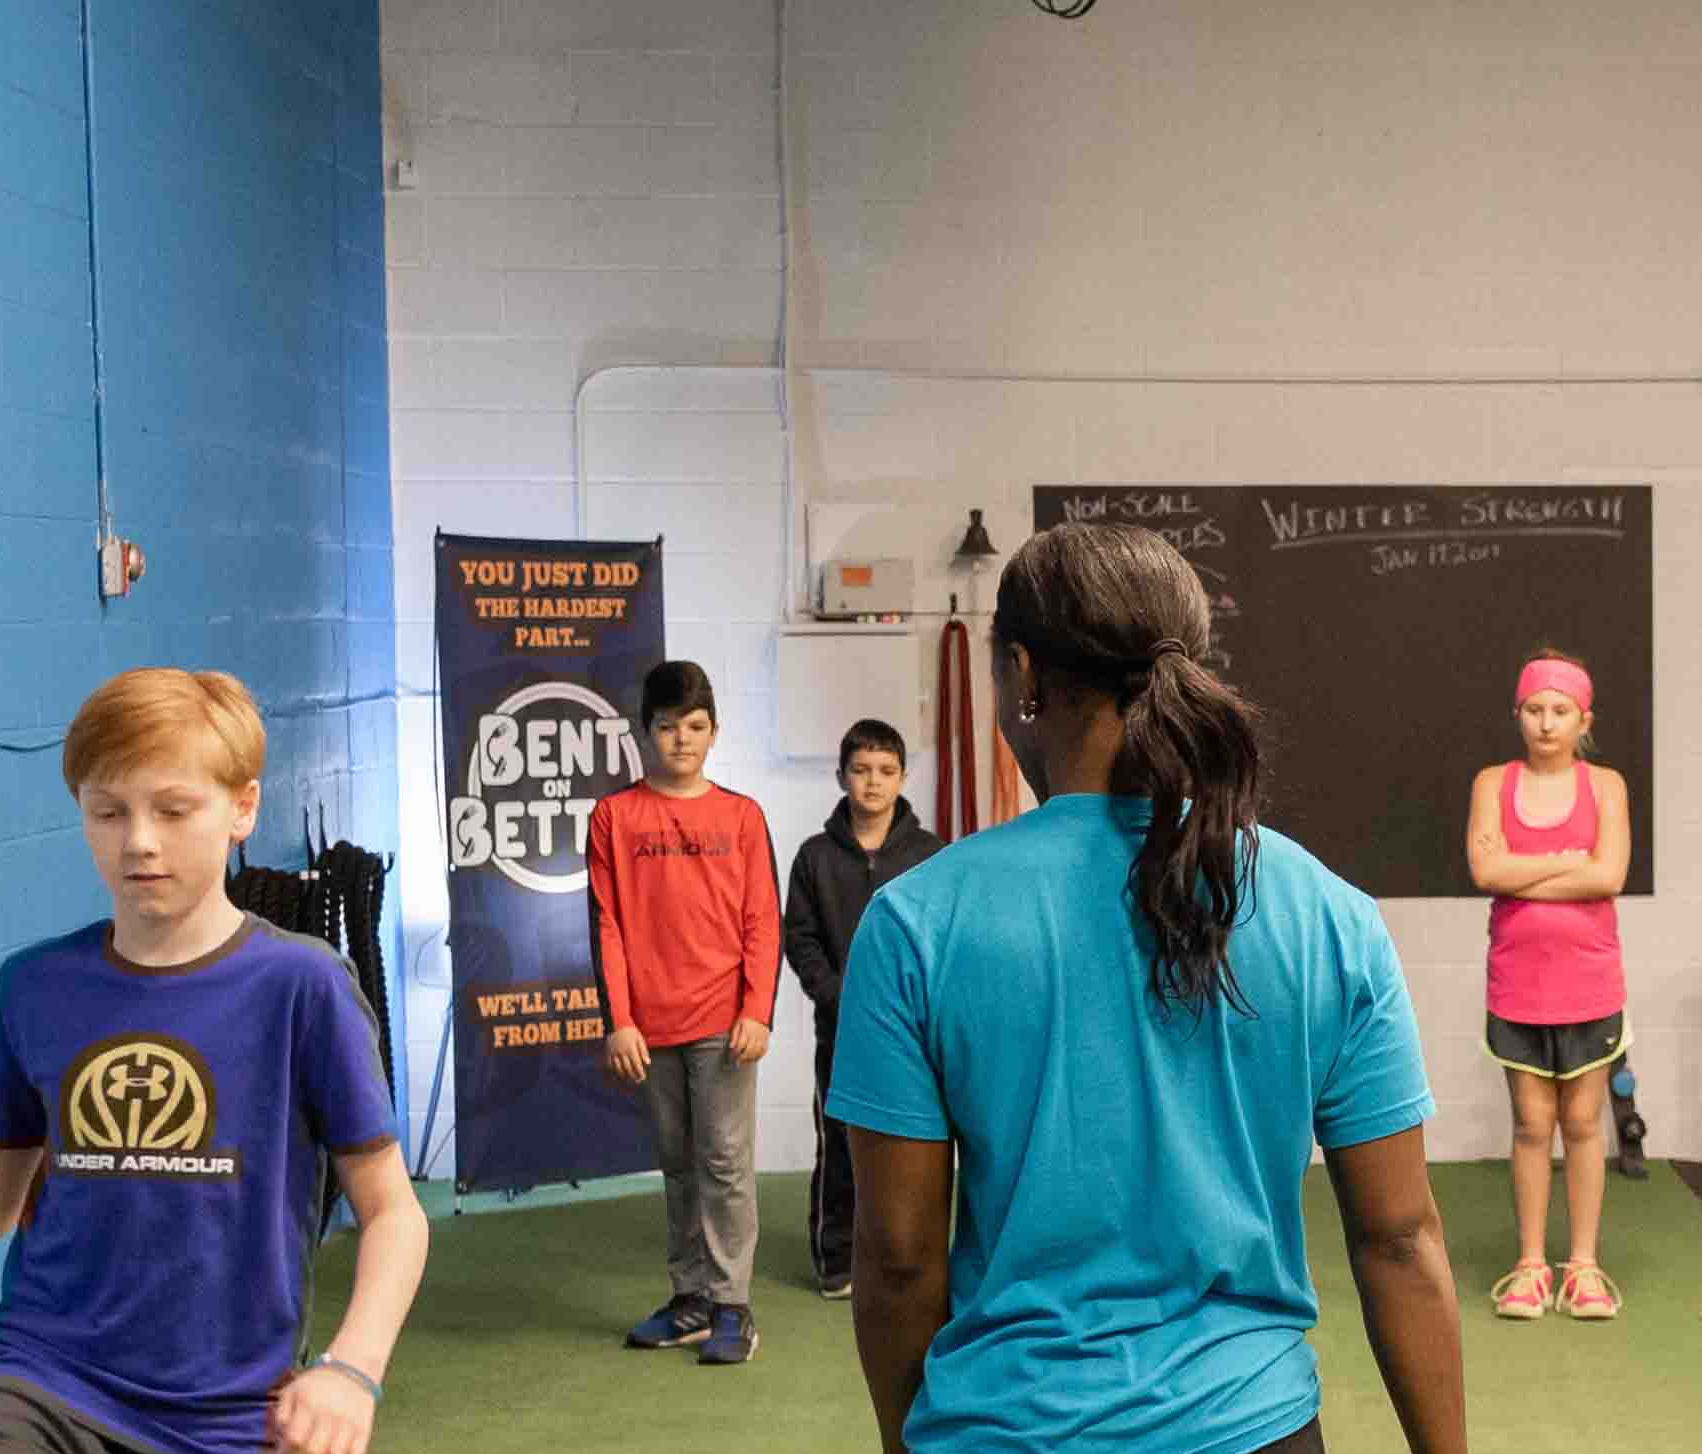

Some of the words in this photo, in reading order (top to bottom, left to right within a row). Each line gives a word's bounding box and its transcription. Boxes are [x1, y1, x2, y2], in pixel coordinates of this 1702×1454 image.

[1260, 499, 1431, 541] WINTER
[1460, 494, 1625, 527] STRENGTH
[459, 559, 516, 587] YOU
[522, 560, 588, 592] JUST
[592, 561, 641, 588] DID
[475, 597, 520, 619] THE
[523, 597, 627, 620] HARDEST
[478, 713, 631, 787] BENT
[542, 778, 572, 799] ON
[449, 796, 598, 868] BETT
[477, 990, 548, 1018] WE'LL
[493, 1020, 561, 1049] FROM
[119, 1154, 235, 1174] ARMOUR
